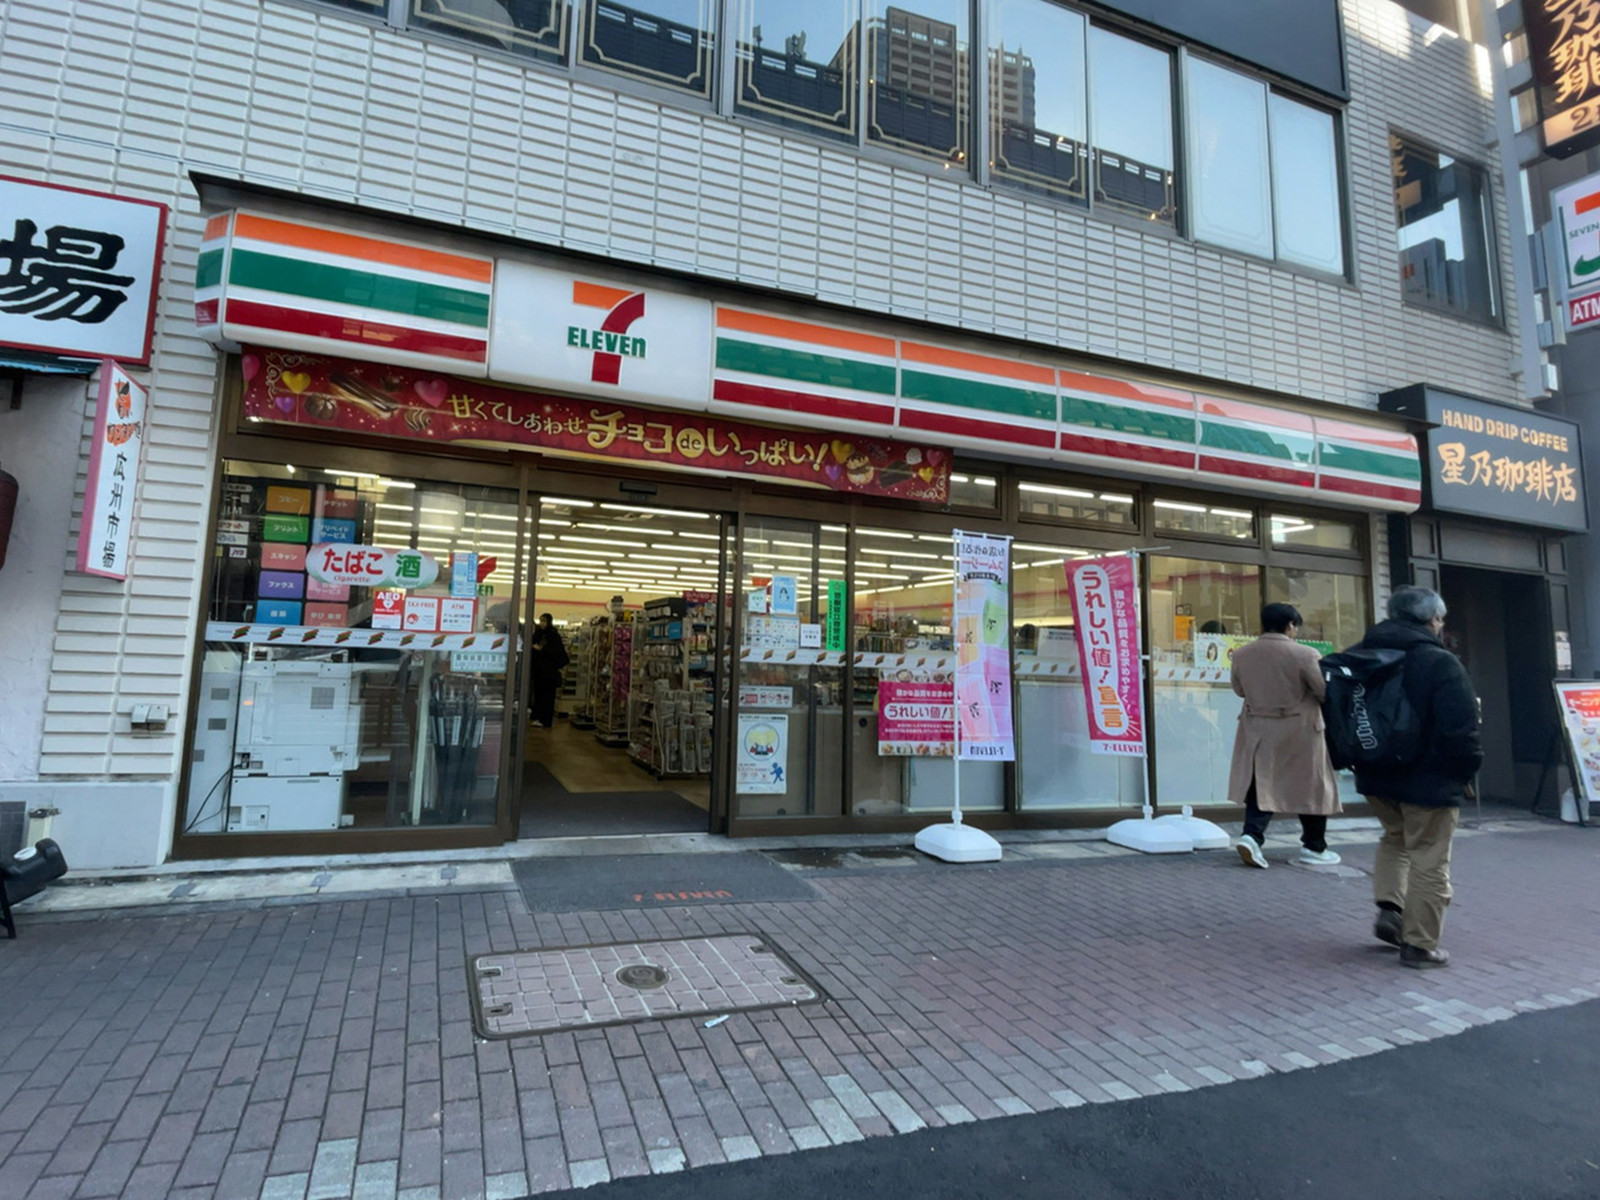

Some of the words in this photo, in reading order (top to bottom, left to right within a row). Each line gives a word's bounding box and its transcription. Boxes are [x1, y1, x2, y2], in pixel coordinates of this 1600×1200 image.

[1543, 0, 1600, 103] 乃珈琲
[0, 219, 136, 324] 場
[572, 280, 646, 387] 7
[1442, 408, 1484, 433] HAND
[1485, 418, 1519, 440] DRIP
[1519, 426, 1569, 452] COFFEE
[1437, 442, 1576, 508] 星乃珈琲店
[273, 524, 300, 533] プリント
[270, 552, 297, 560] スキャン
[322, 548, 383, 575] たばこ
[395, 553, 422, 578] 酒
[268, 580, 294, 589] ファクス
[377, 591, 401, 600] AED
